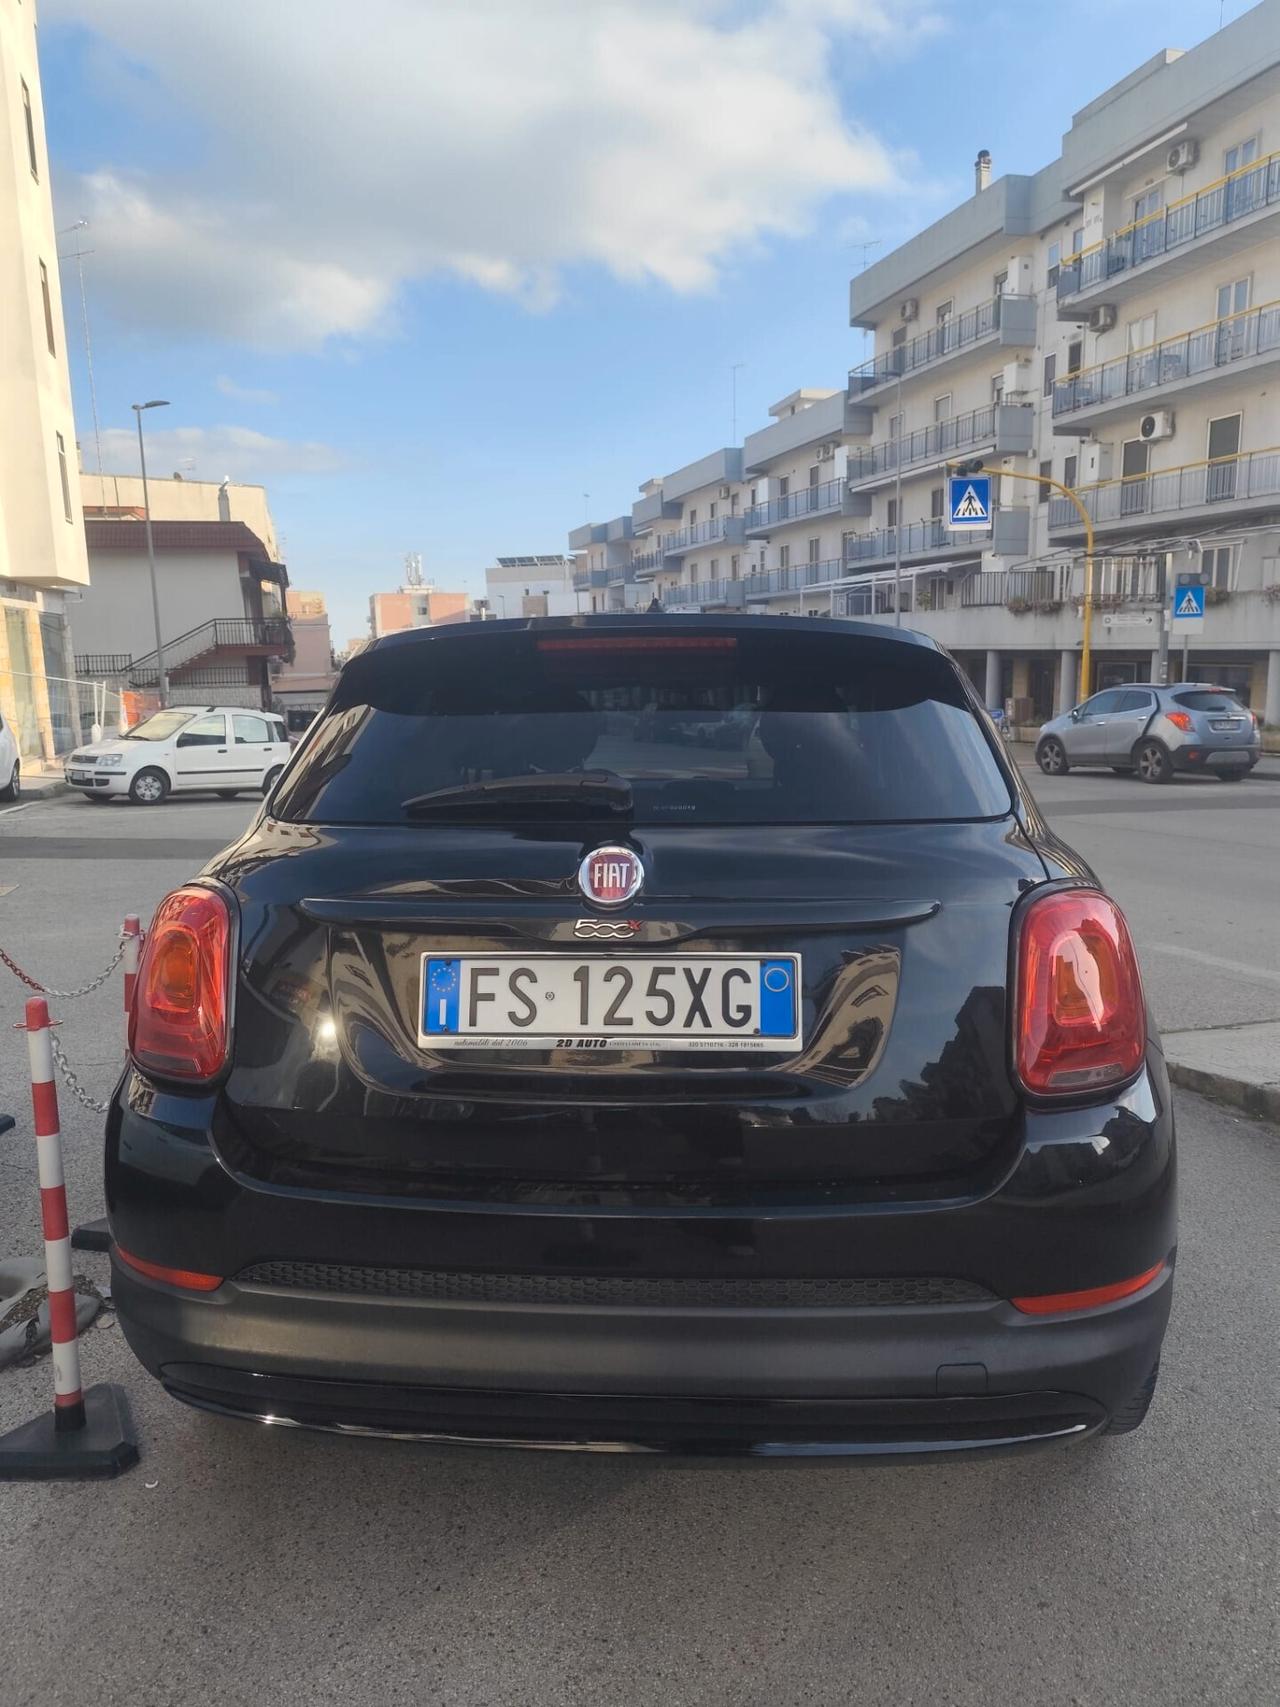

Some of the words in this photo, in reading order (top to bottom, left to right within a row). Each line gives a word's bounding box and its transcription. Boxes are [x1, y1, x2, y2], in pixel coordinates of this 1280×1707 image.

[594, 862, 630, 888] FIAT
[469, 967, 538, 1028] FS
[573, 966, 752, 1028] 125XG
[556, 1039, 572, 1048] 2D
[576, 1039, 607, 1048] AUTO
